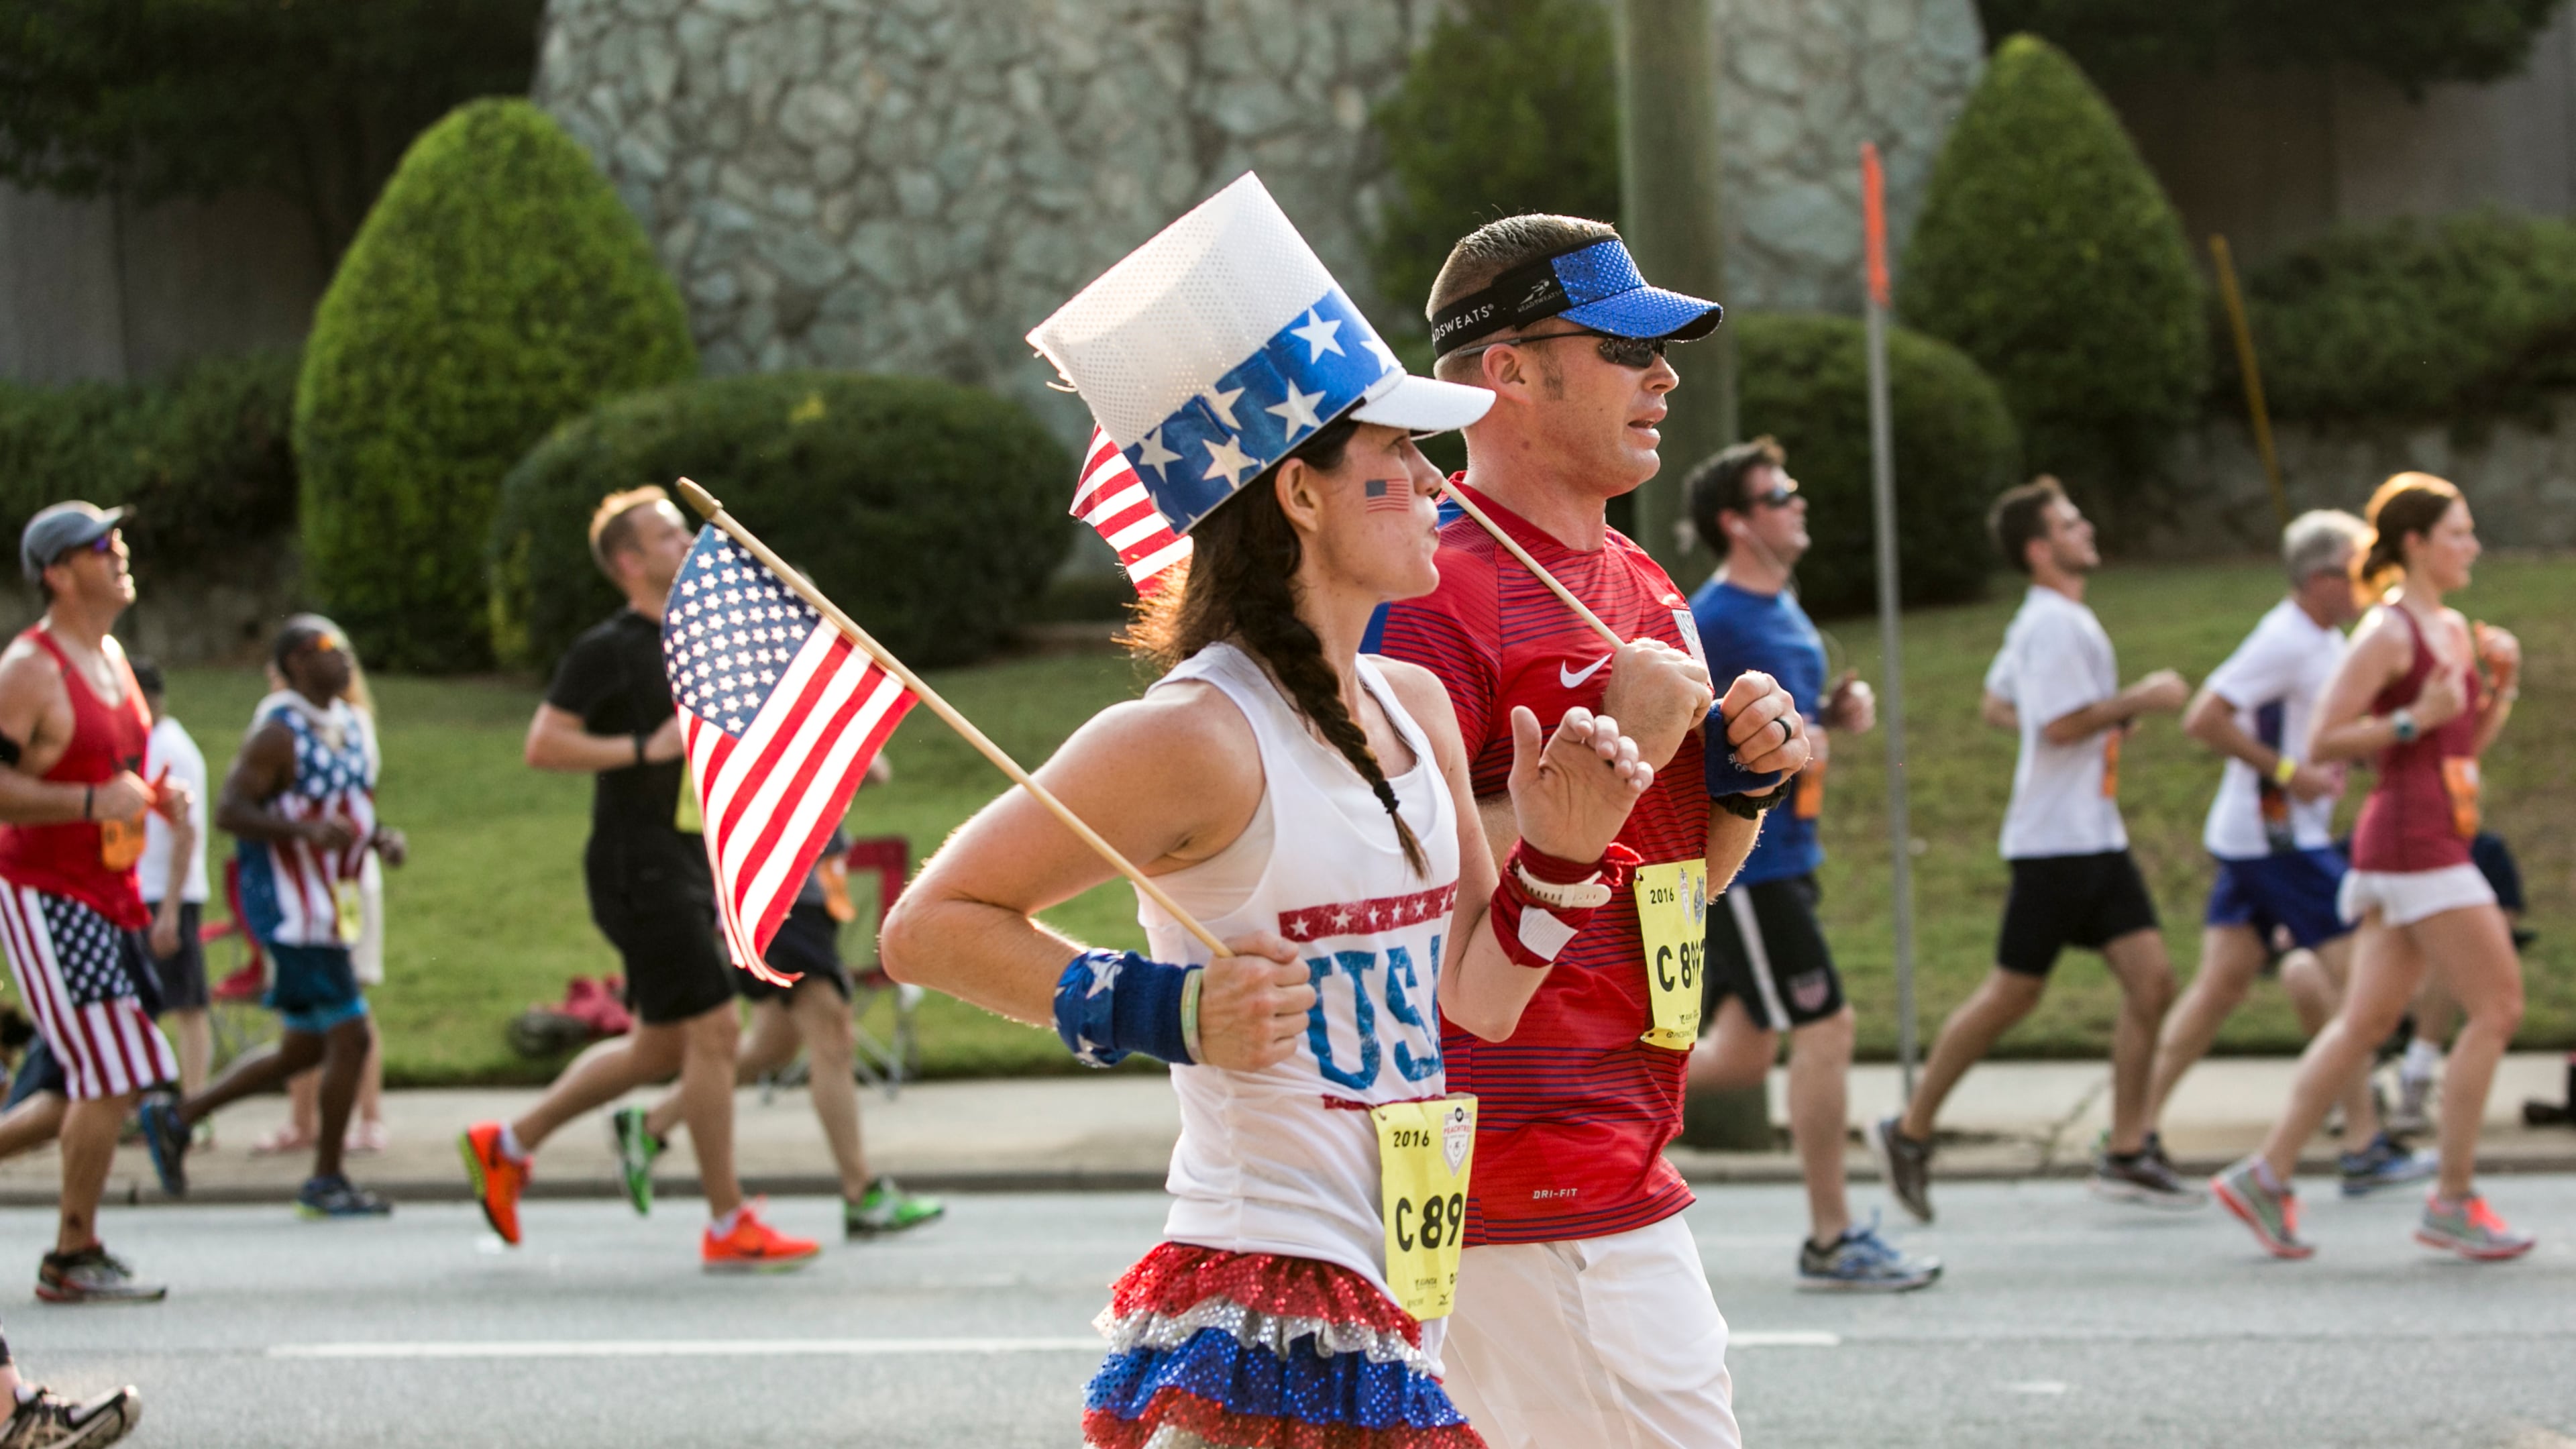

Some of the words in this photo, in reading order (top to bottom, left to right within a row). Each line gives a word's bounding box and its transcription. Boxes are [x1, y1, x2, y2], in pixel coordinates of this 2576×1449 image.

[1650, 886, 1674, 904] 2016
[1393, 1130, 1430, 1148] 2016
[1532, 1188, 1577, 1199] DRI-FIT
